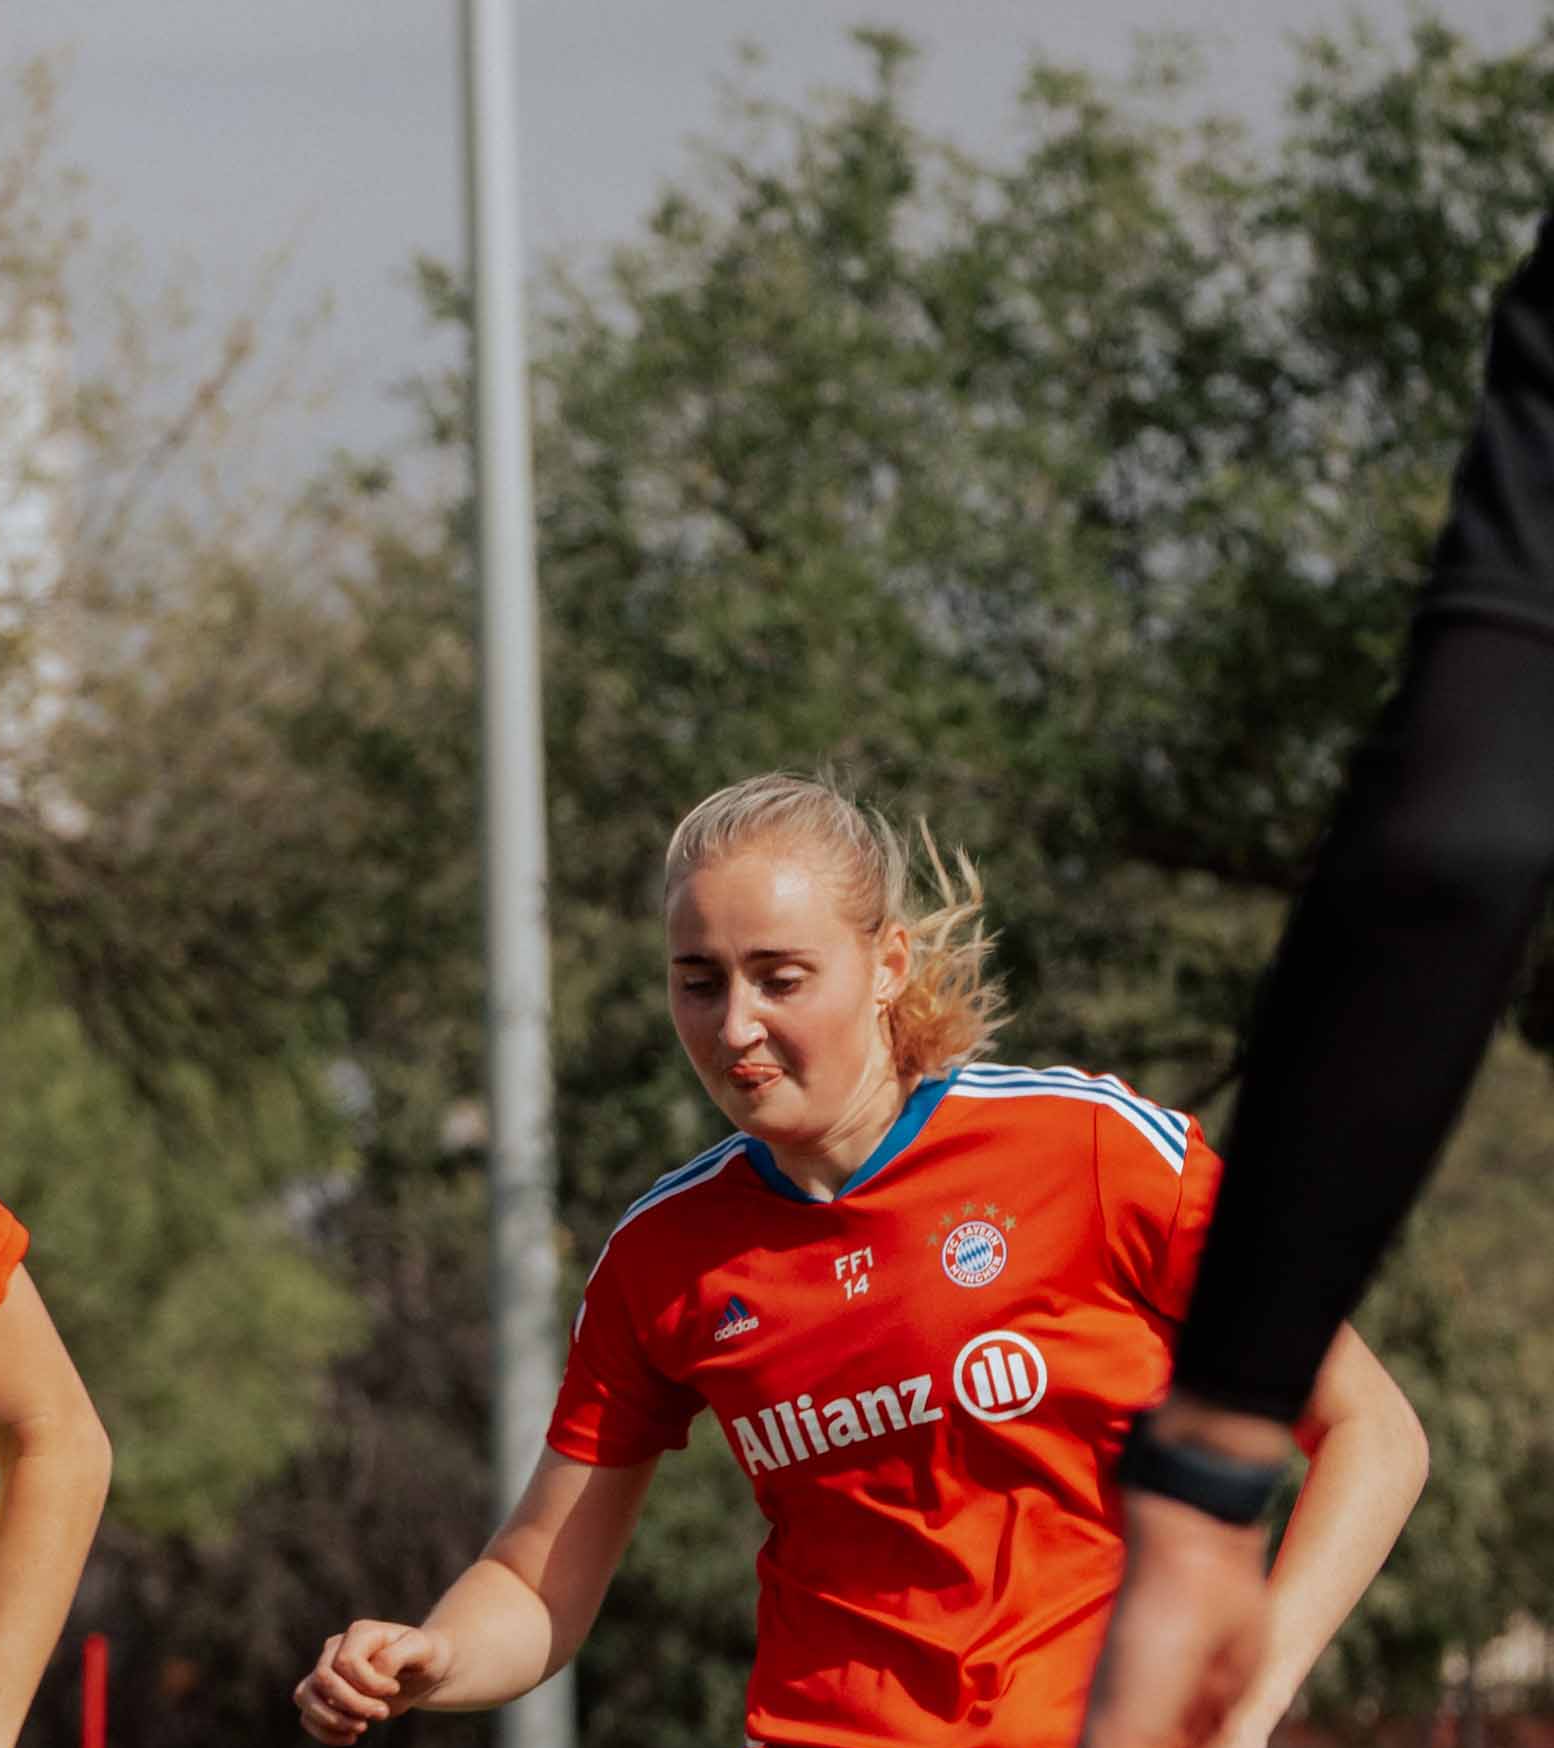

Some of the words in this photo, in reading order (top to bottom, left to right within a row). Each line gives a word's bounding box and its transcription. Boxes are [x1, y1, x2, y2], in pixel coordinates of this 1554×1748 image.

[834, 1247, 875, 1281] FF1
[843, 1277, 870, 1300] 14
[714, 1316, 760, 1343] adidas
[732, 1373, 944, 1477] Allianz
